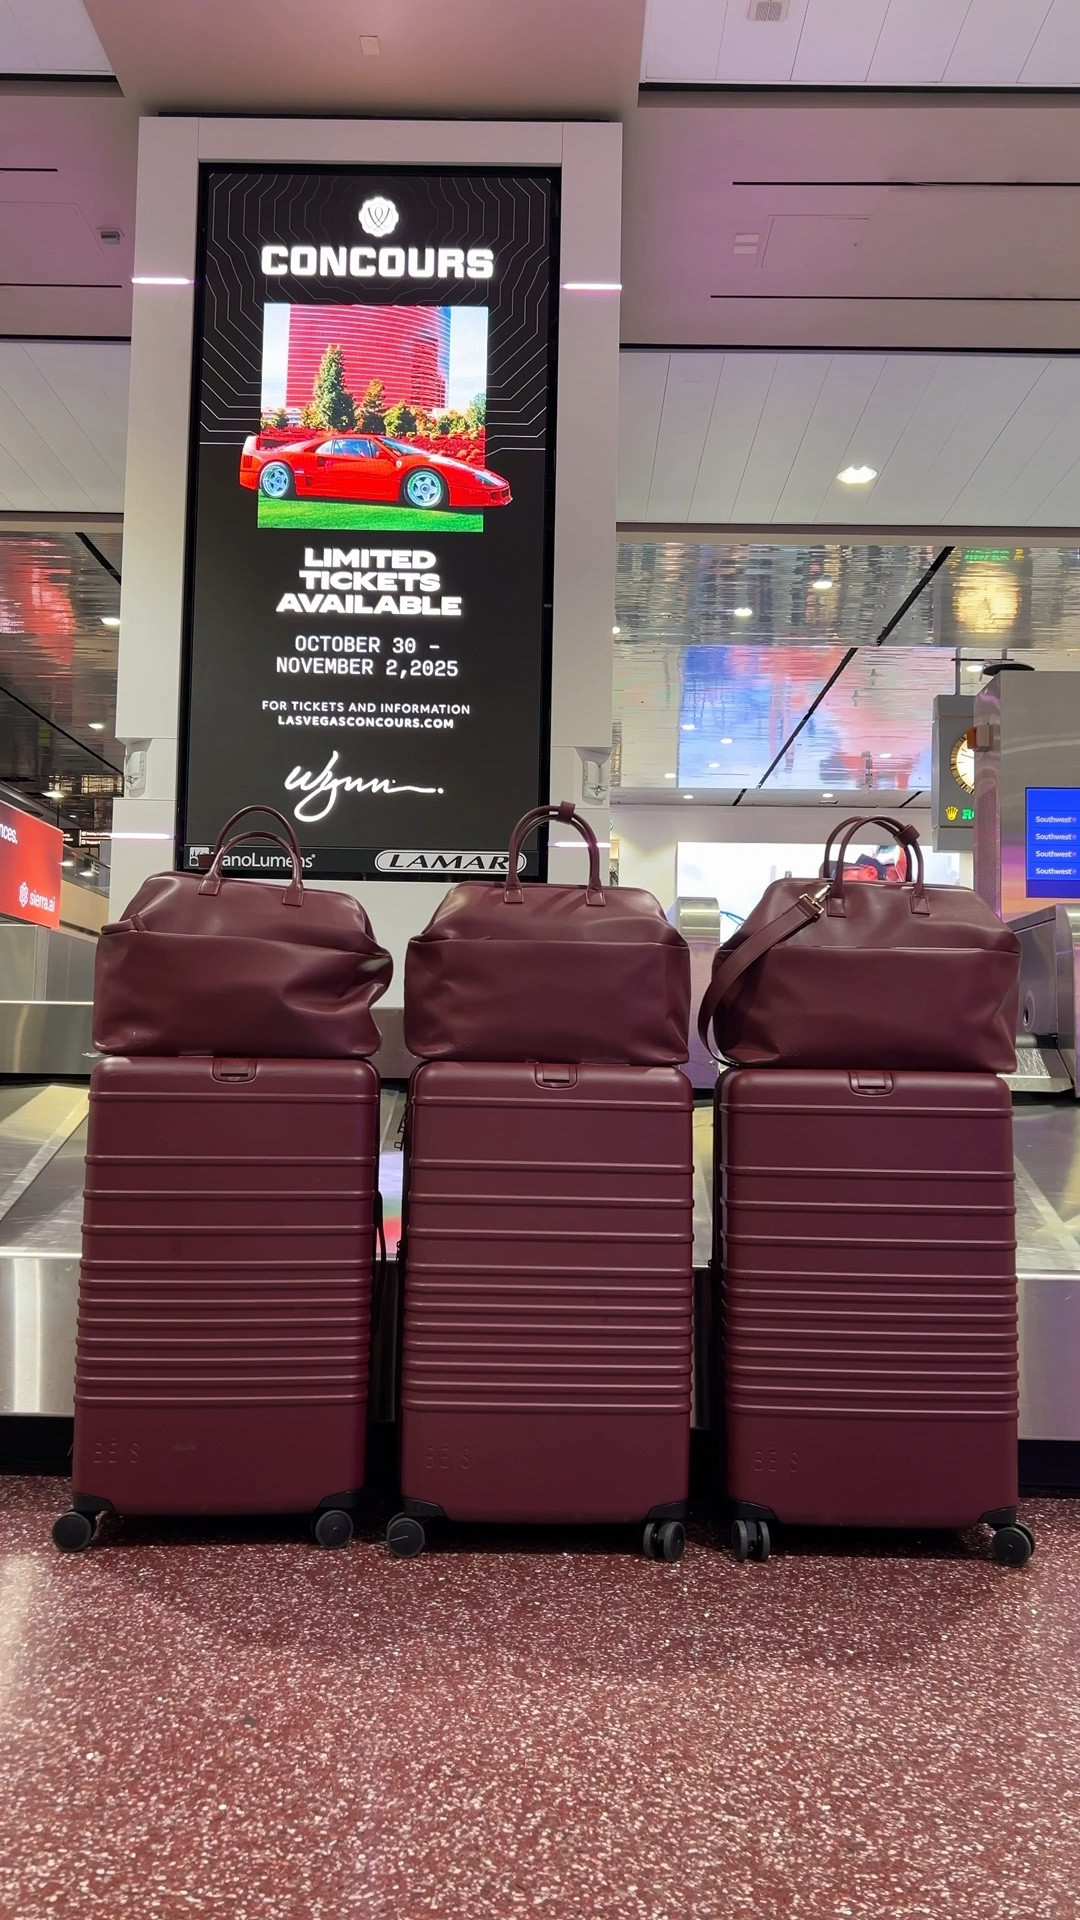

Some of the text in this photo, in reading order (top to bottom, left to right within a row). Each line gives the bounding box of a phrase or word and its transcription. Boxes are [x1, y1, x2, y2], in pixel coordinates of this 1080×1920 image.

[261, 245, 494, 279] CONCOURS
[304, 547, 437, 570] LIMITED
[298, 570, 441, 592] TICKETS
[275, 593, 463, 616] AVAILABLE
[294, 635, 381, 653] OCTOBER
[392, 637, 417, 654] 30
[276, 656, 459, 679] NOVEMBER 2,2025
[261, 700, 471, 715] FOR TICKETS AND INFORMATION
[277, 715, 454, 729] LASVEGASCONCOURS.COM
[1035, 815, 1072, 824] Southwest
[1035, 832, 1072, 841] Southwest
[210, 851, 313, 869] anoLumens
[389, 854, 509, 870] LAMAR
[1035, 850, 1072, 858] Southwest
[1035, 867, 1072, 875] Southwest
[29, 888, 56, 913] sierra.ai
